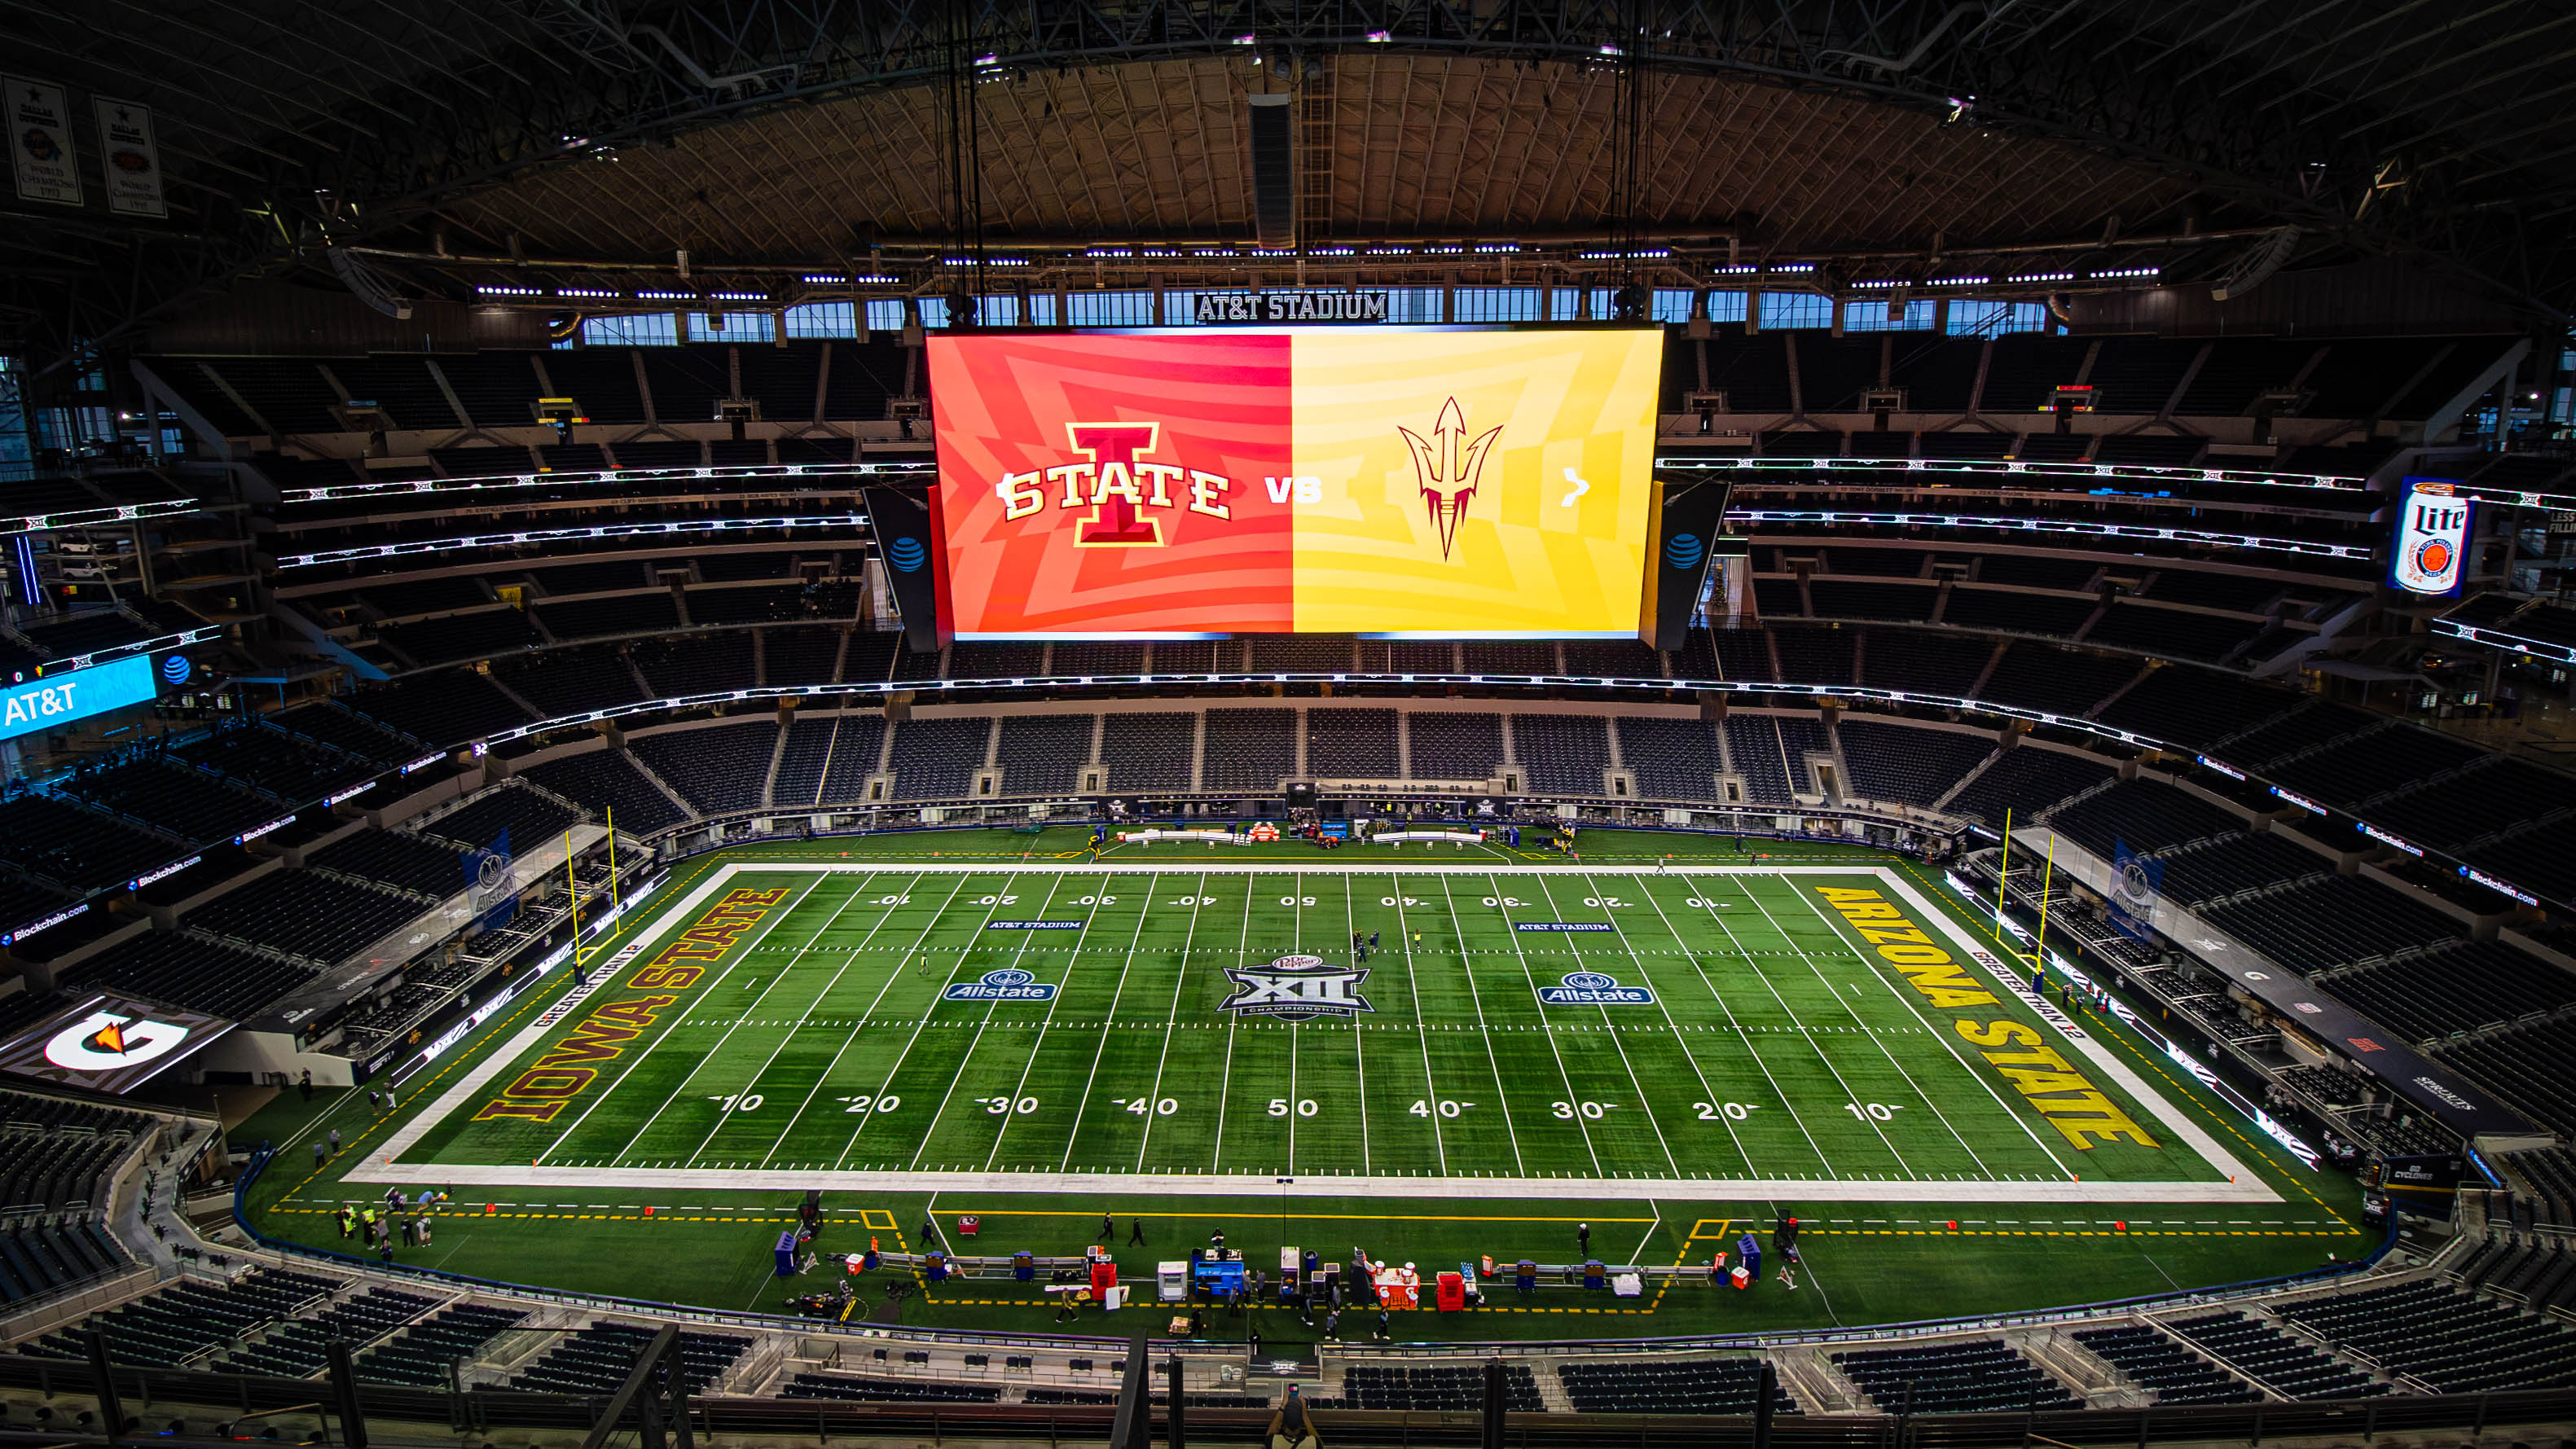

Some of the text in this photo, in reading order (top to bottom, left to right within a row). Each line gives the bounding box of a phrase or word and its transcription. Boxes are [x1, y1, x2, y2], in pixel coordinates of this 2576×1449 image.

[1197, 294, 1387, 319] AT&T STADIUM
[1004, 461, 1231, 522] STATE
[1265, 476, 1321, 504] VS
[2413, 505, 2464, 535] Lite
[2550, 512, 2576, 522] LESS
[5, 683, 77, 726] AT&T
[2276, 788, 2328, 816] Blockchain.com
[243, 815, 297, 842] Blockchain.com
[2365, 825, 2424, 858] Blockchain.com
[138, 855, 201, 888] Blockchain.com
[2468, 868, 2539, 907] Blockchain.com
[2111, 889, 2152, 922] Allstate
[14, 904, 89, 942] Blockchain.com
[534, 982, 600, 1027] GREATER
[588, 957, 628, 981] THAN
[949, 986, 1046, 998] Allstate
[1231, 973, 1361, 1006] XII
[1546, 989, 1642, 1001] Allstate
[1972, 951, 2086, 1038] GREATER THAN 12
[470, 887, 791, 1123] IOWA STATE
[1815, 886, 2163, 1151] ARIZONA STATE
[719, 1094, 764, 1112] 10
[845, 1096, 900, 1113] 20
[987, 1096, 1039, 1114] 30
[1127, 1097, 1178, 1116] 40
[2416, 1076, 2477, 1111] SPROUTS
[1268, 1099, 1318, 1117] 50
[1409, 1100, 1461, 1118] 40
[1551, 1101, 1603, 1119] 30
[1692, 1102, 1747, 1121] 20
[1844, 1103, 1892, 1121] 10
[2394, 1170, 2433, 1180] CYCLONES
